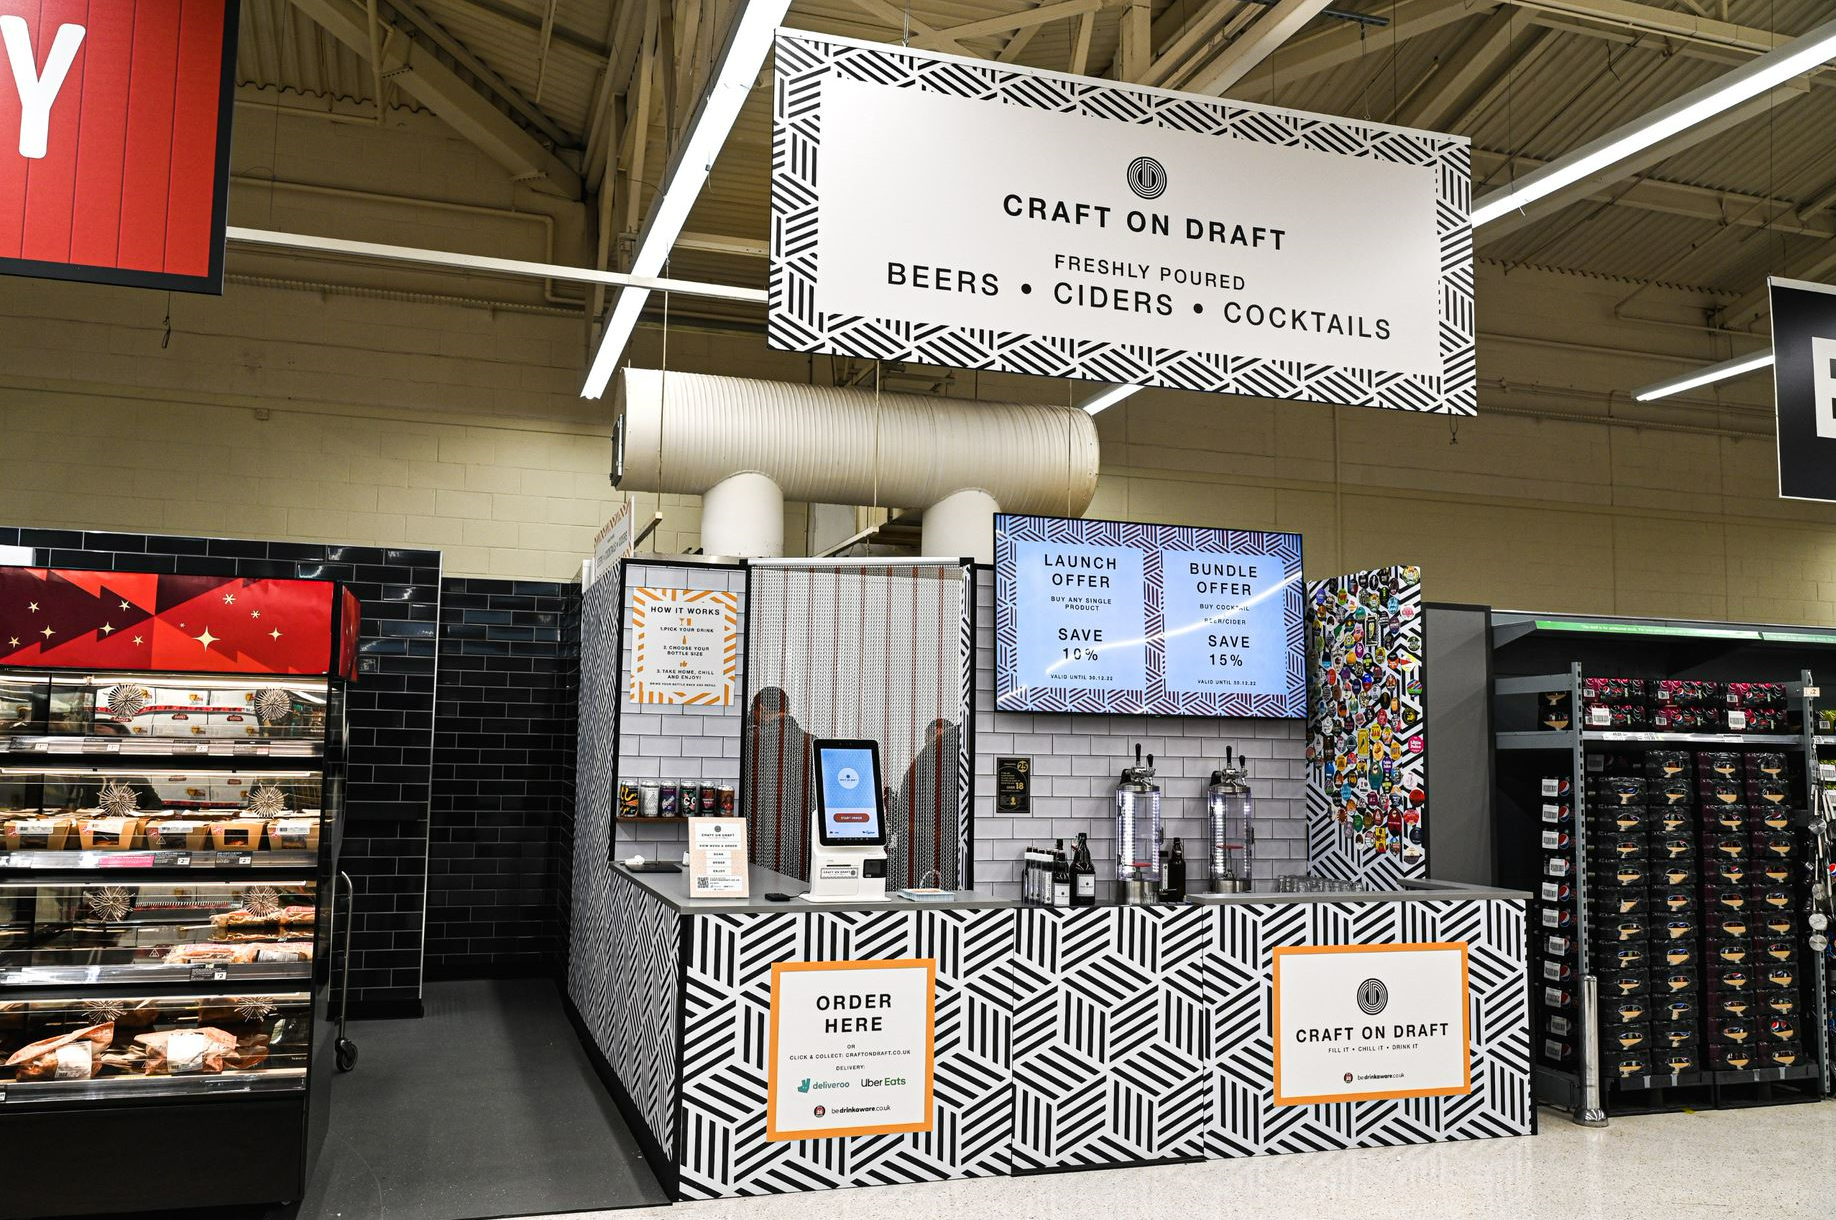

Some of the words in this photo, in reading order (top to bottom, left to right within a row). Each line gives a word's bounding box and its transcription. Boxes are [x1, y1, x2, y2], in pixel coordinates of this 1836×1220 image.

[0, 15, 86, 159] Y
[1003, 194, 1110, 228] CRAFT
[1127, 210, 1169, 236] ON
[1186, 218, 1286, 250] DRAFT
[1055, 254, 1150, 279] FRESHLY
[1160, 267, 1245, 290] POURED
[887, 262, 999, 296] BEERS
[1053, 281, 1173, 316] CIDERS
[1223, 301, 1391, 340] COCKTAILS
[1045, 554, 1116, 570] LAUNCH
[1190, 563, 1257, 578] BUNDLE
[1052, 573, 1110, 588] OFFER
[1197, 582, 1251, 595] OFFER
[1058, 628, 1102, 642] SAVE
[1208, 635, 1250, 648] SAVE
[1063, 648, 1098, 660] 10%
[1210, 654, 1242, 666] 15%
[816, 994, 892, 1010] ORDER
[825, 1017, 882, 1033] HERE
[1296, 1027, 1354, 1042] CRAFT
[1362, 1026, 1385, 1039] ON
[1394, 1022, 1449, 1038] DRAFT
[812, 1081, 850, 1090] deliveroo
[861, 1079, 883, 1087] Uber
[885, 1077, 906, 1086] Eats
[831, 1105, 891, 1114] bedrinkaware.co.uk
